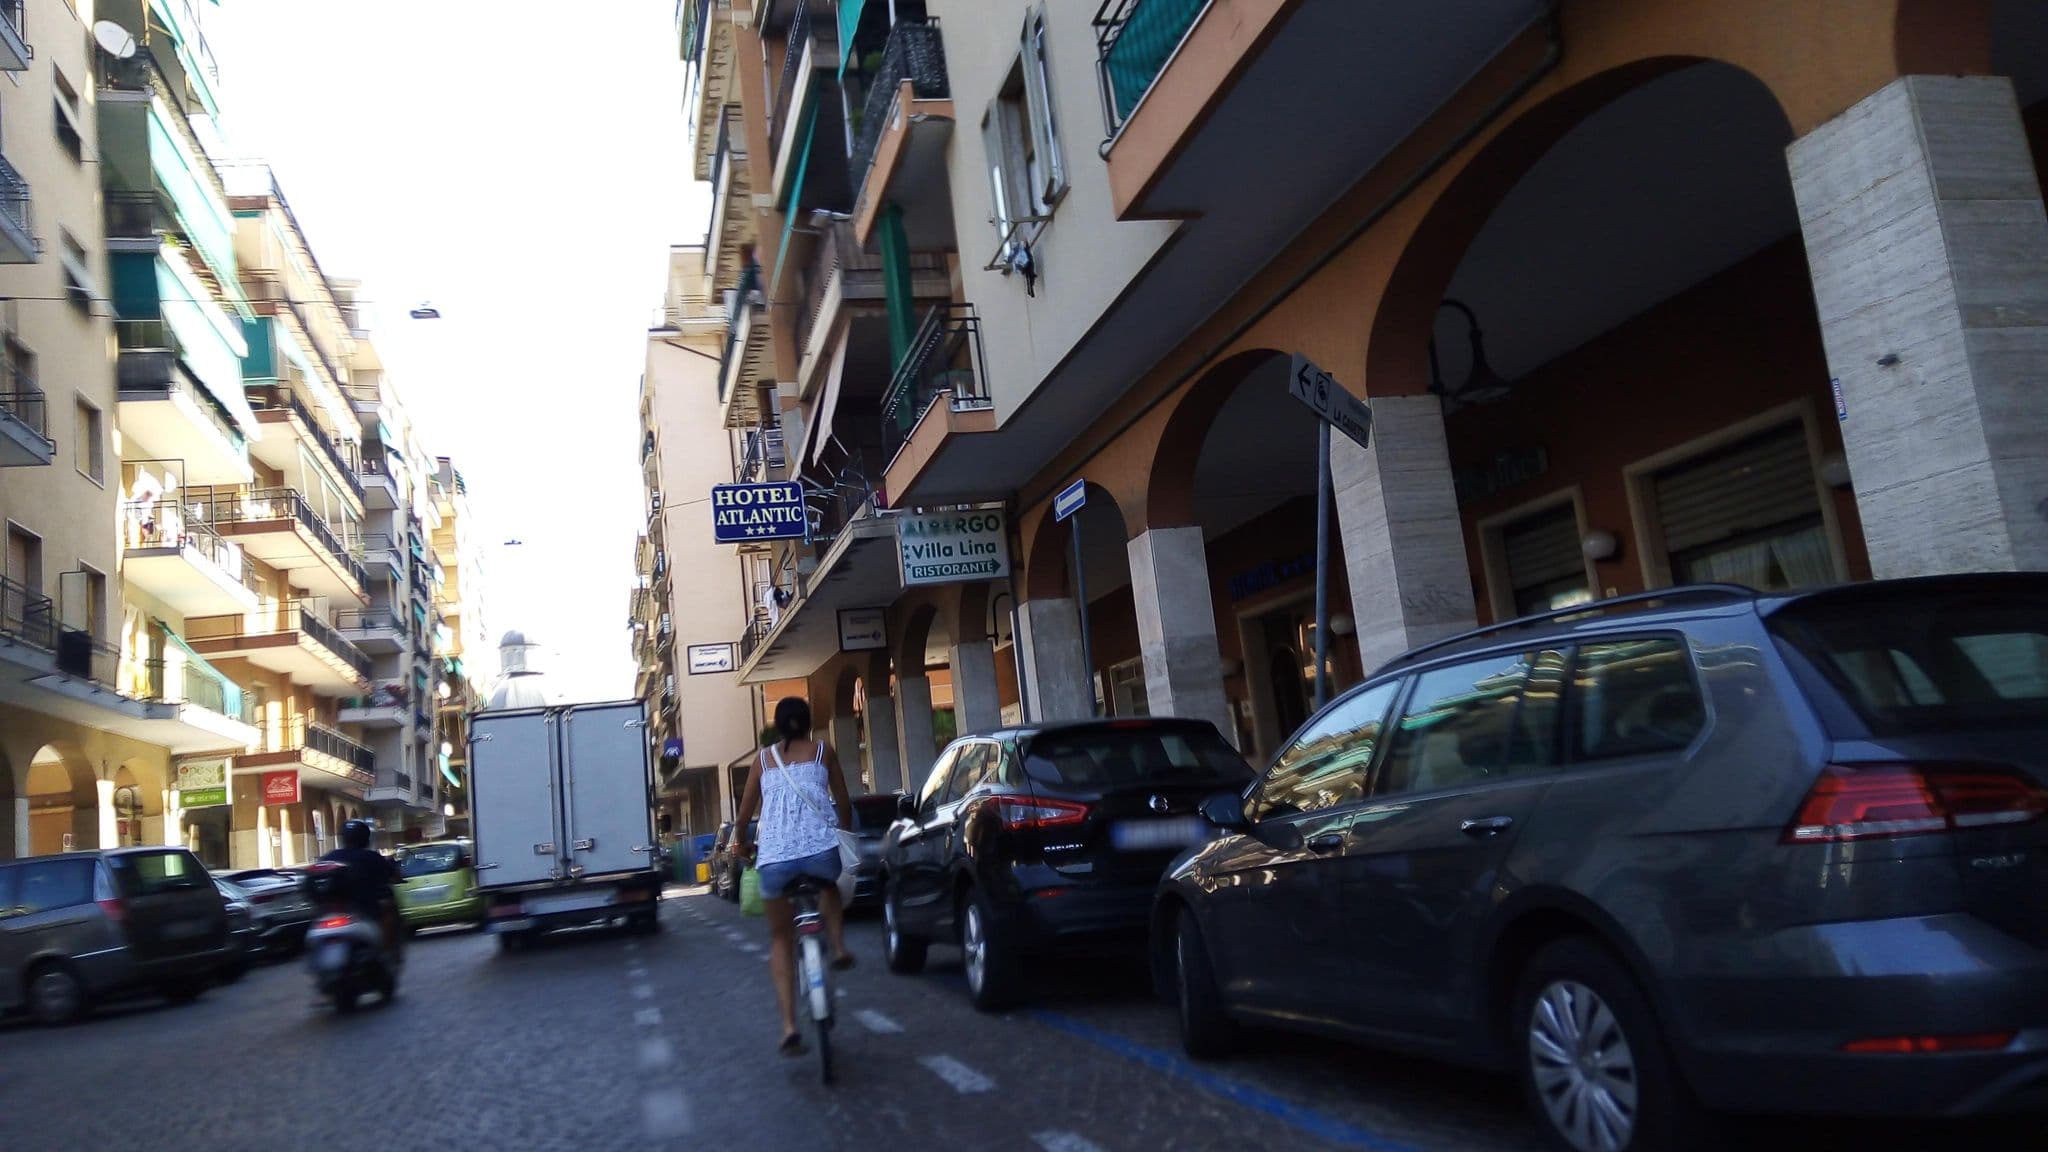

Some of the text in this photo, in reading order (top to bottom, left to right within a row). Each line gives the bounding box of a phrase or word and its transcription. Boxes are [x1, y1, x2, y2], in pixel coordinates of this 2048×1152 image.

[715, 487, 799, 506] HOTEL
[717, 506, 802, 526] ATLANTIC
[912, 540, 996, 559] Villa Lina
[915, 562, 993, 577] RISTORANTE
